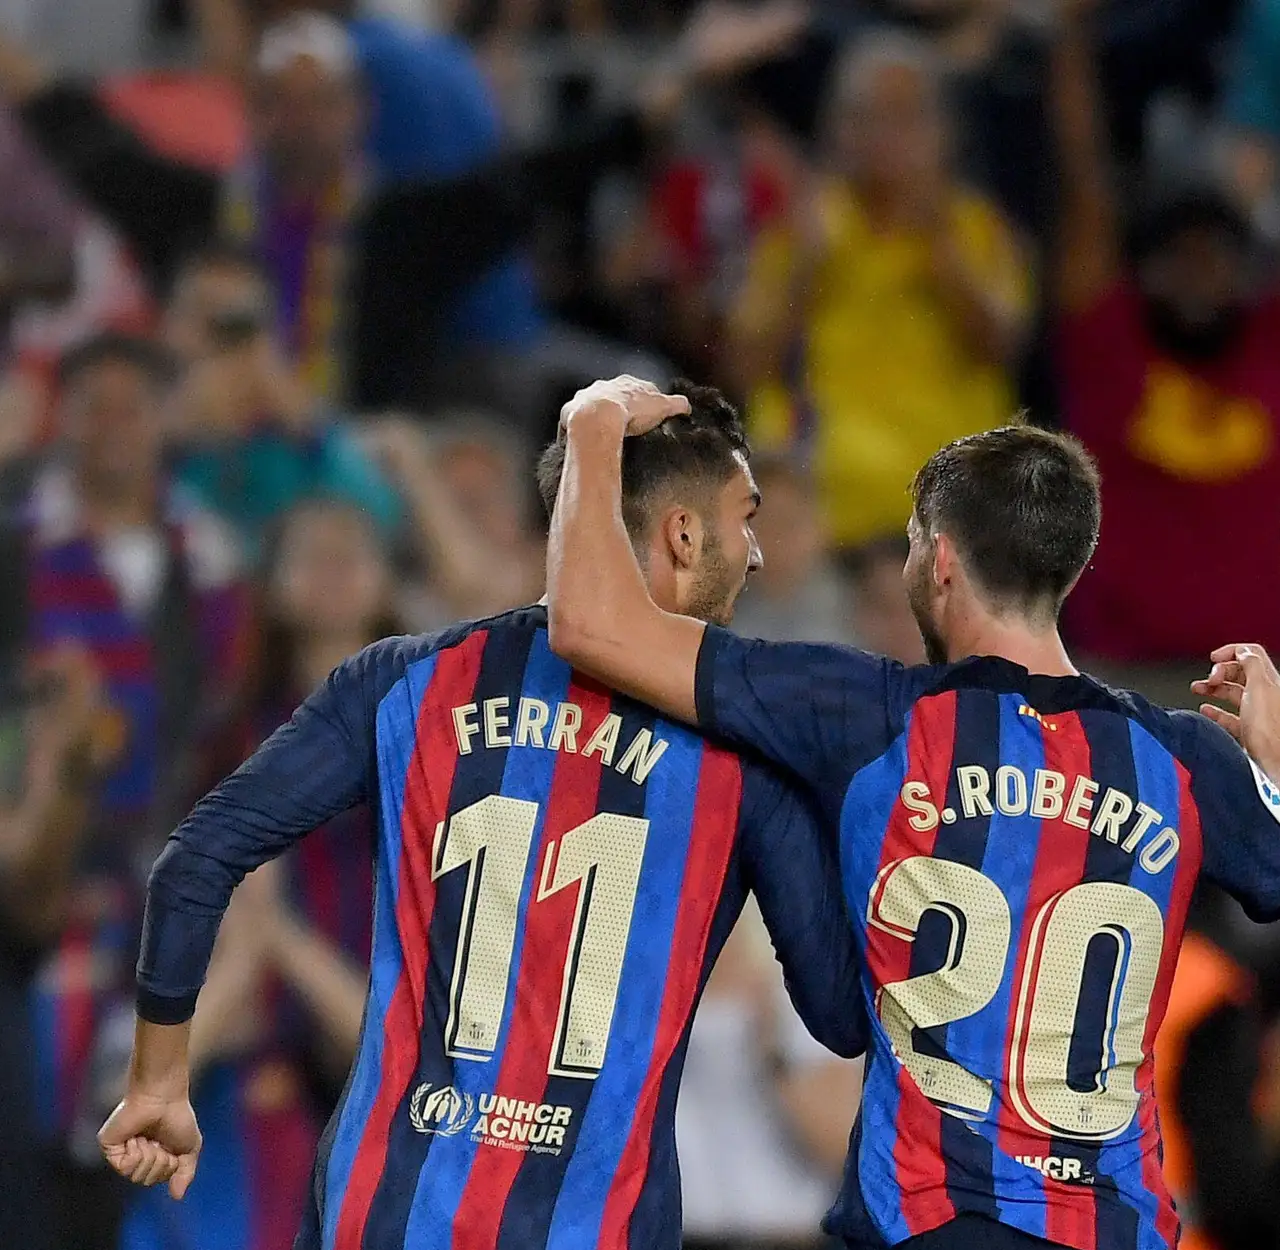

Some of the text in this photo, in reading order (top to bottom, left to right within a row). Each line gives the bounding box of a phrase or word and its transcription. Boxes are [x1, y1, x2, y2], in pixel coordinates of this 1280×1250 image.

[451, 696, 669, 786] FERRAN
[900, 765, 1180, 875] S.ROBERTO
[430, 794, 650, 1079] 11
[866, 855, 1165, 1141] 20
[472, 1115, 566, 1146] ACNUR
[478, 1093, 572, 1125] UNHCR
[484, 1137, 498, 1146] UN
[499, 1140, 530, 1153] Refugee
[531, 1144, 562, 1156] Agency
